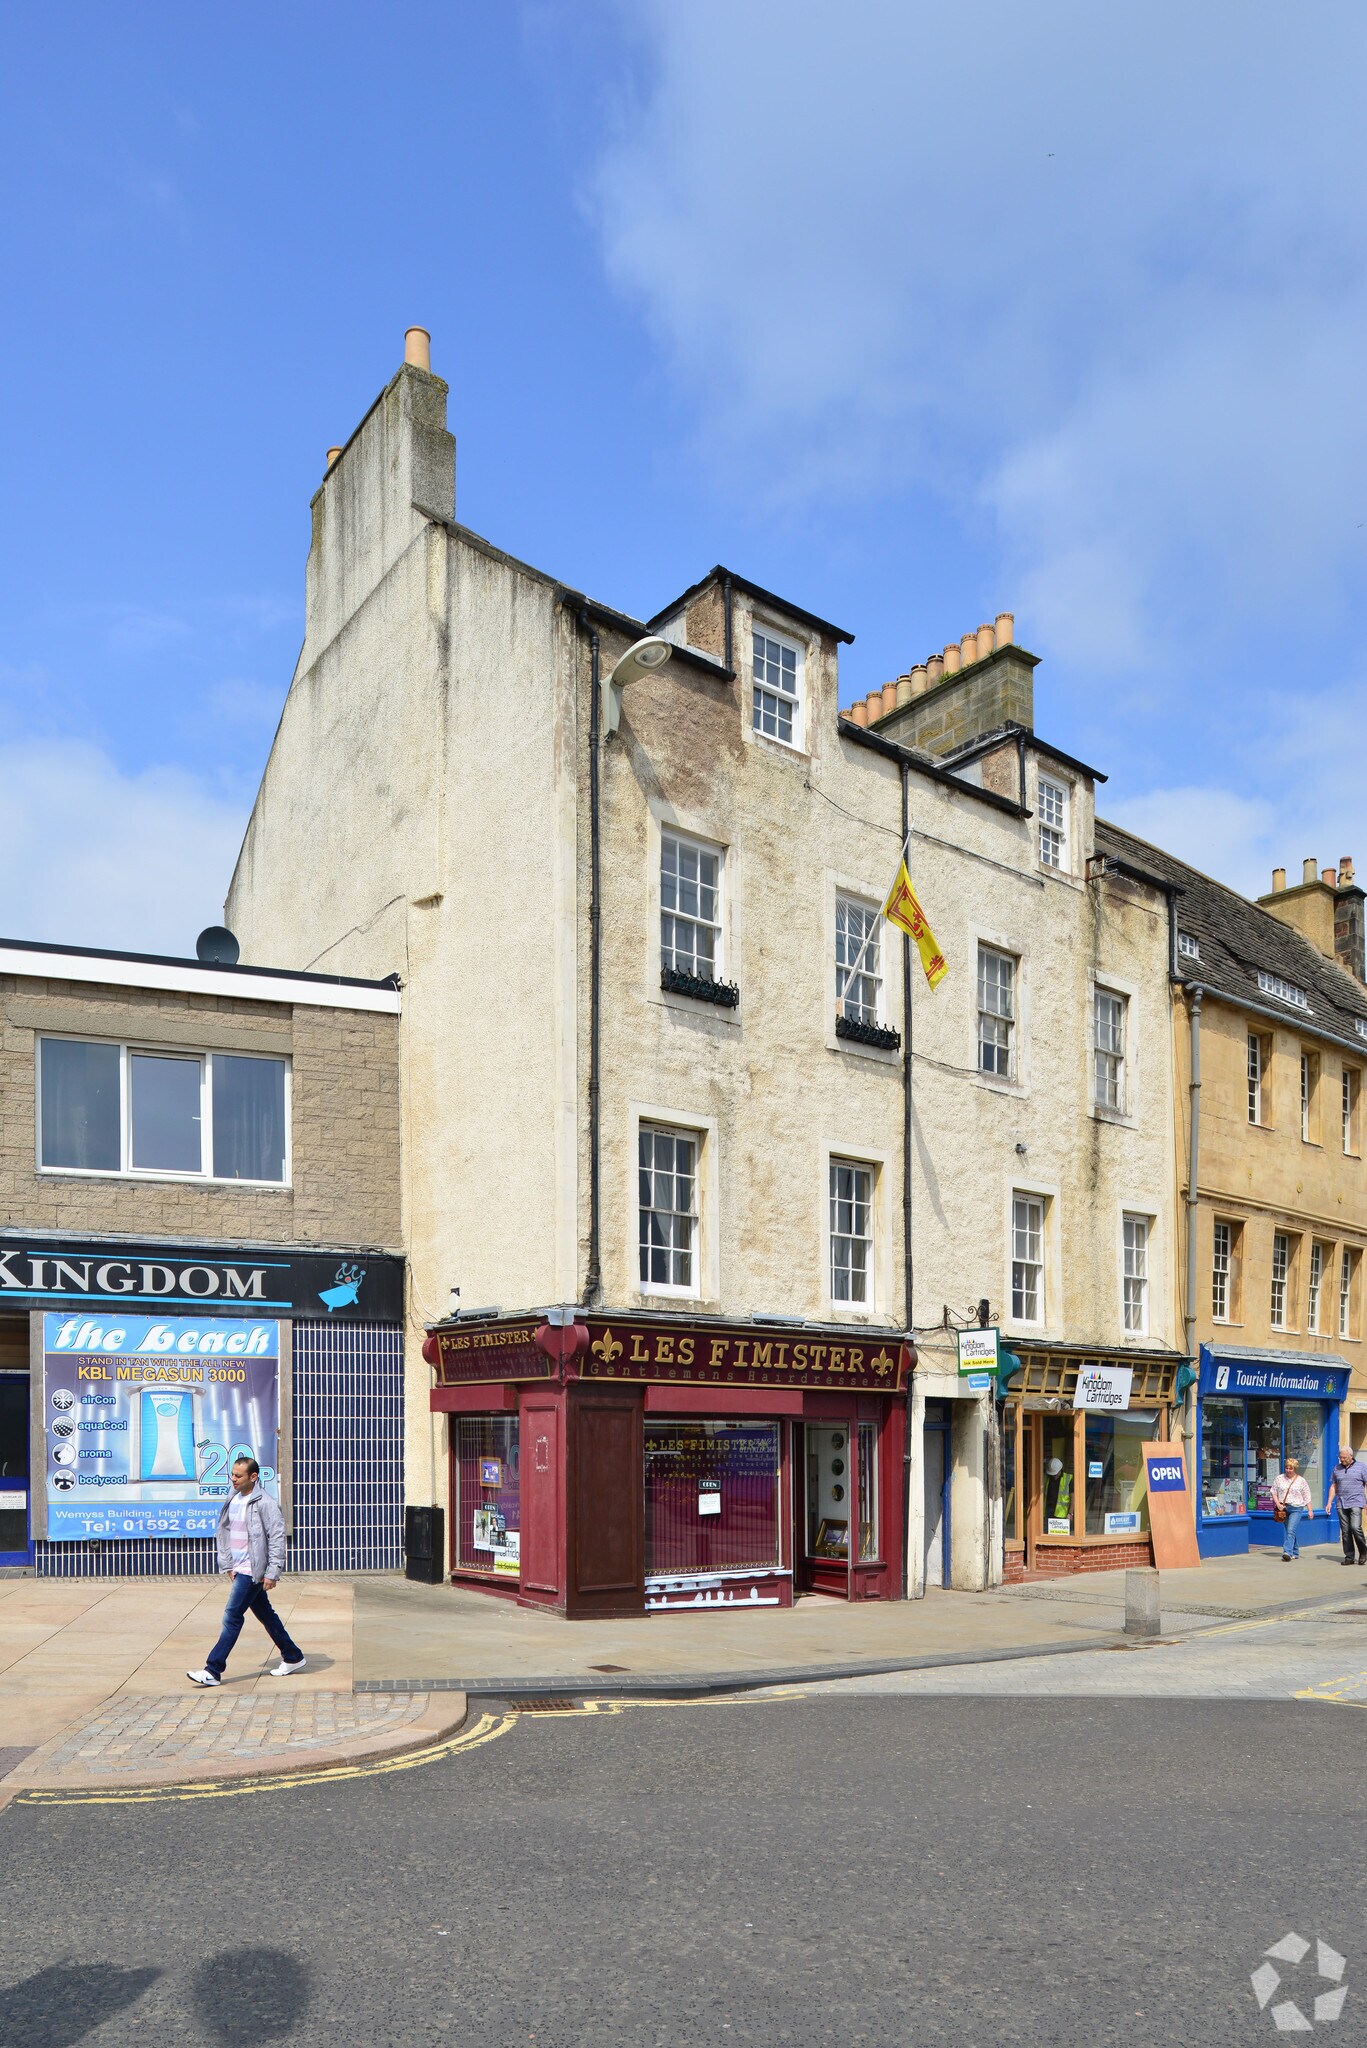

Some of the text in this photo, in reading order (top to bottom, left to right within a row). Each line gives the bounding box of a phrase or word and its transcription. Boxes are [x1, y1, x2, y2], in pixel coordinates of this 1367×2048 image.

[55, 1320, 269, 1353] the beach
[451, 1330, 530, 1349] LES FIMISTER
[961, 1342, 985, 1351] Kingdom
[630, 1335, 865, 1373] LES FIMISTER
[78, 1357, 113, 1365] STAND
[128, 1358, 149, 1366] TAN
[78, 1366, 246, 1382] KBL MEGASUN 3000
[590, 1363, 892, 1387] Gentlemens Hairdressers
[1236, 1369, 1267, 1387] Tourist
[1269, 1372, 1319, 1390] Information
[1082, 1377, 1113, 1393] Kingdom
[81, 1395, 117, 1405] airCon
[1086, 1390, 1123, 1405] Cartridges
[78, 1420, 128, 1431] aquaCool
[660, 1440, 684, 1451] LES
[79, 1450, 112, 1458] aroma
[1151, 1467, 1182, 1481] OPEN
[79, 1476, 128, 1487] bodycool
[107, 1510, 155, 1518] Building,
[158, 1509, 184, 1517] High
[82, 1520, 116, 1532] Tel:
[123, 1519, 180, 1531] 01592
